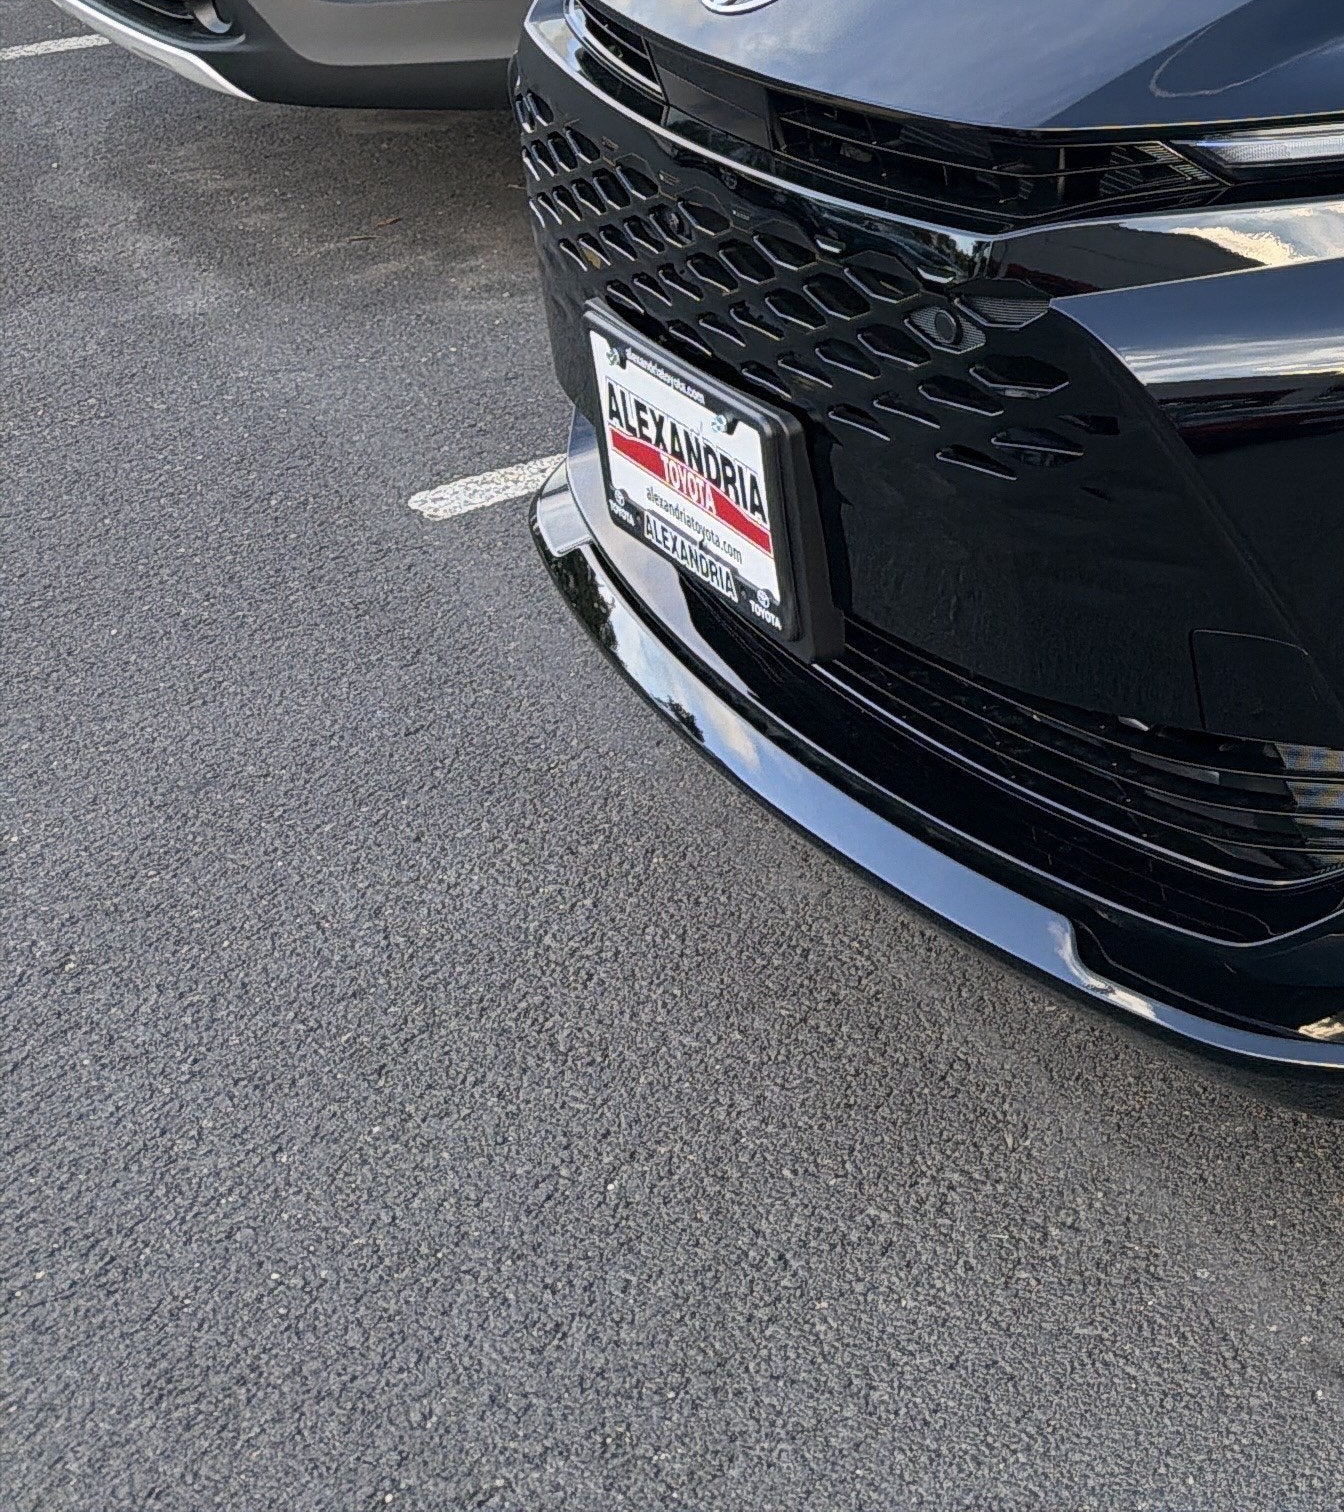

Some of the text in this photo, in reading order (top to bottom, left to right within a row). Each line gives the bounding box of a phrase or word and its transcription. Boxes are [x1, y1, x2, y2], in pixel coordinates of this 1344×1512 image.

[608, 381, 768, 526] ALEXANDRIA
[661, 458, 717, 515] TOYOTA
[608, 498, 636, 527] TOYOTA
[646, 486, 743, 565] alexandriatoyota.com
[645, 514, 738, 603] ALEXANDRIA
[749, 599, 783, 631] TOYOTA
